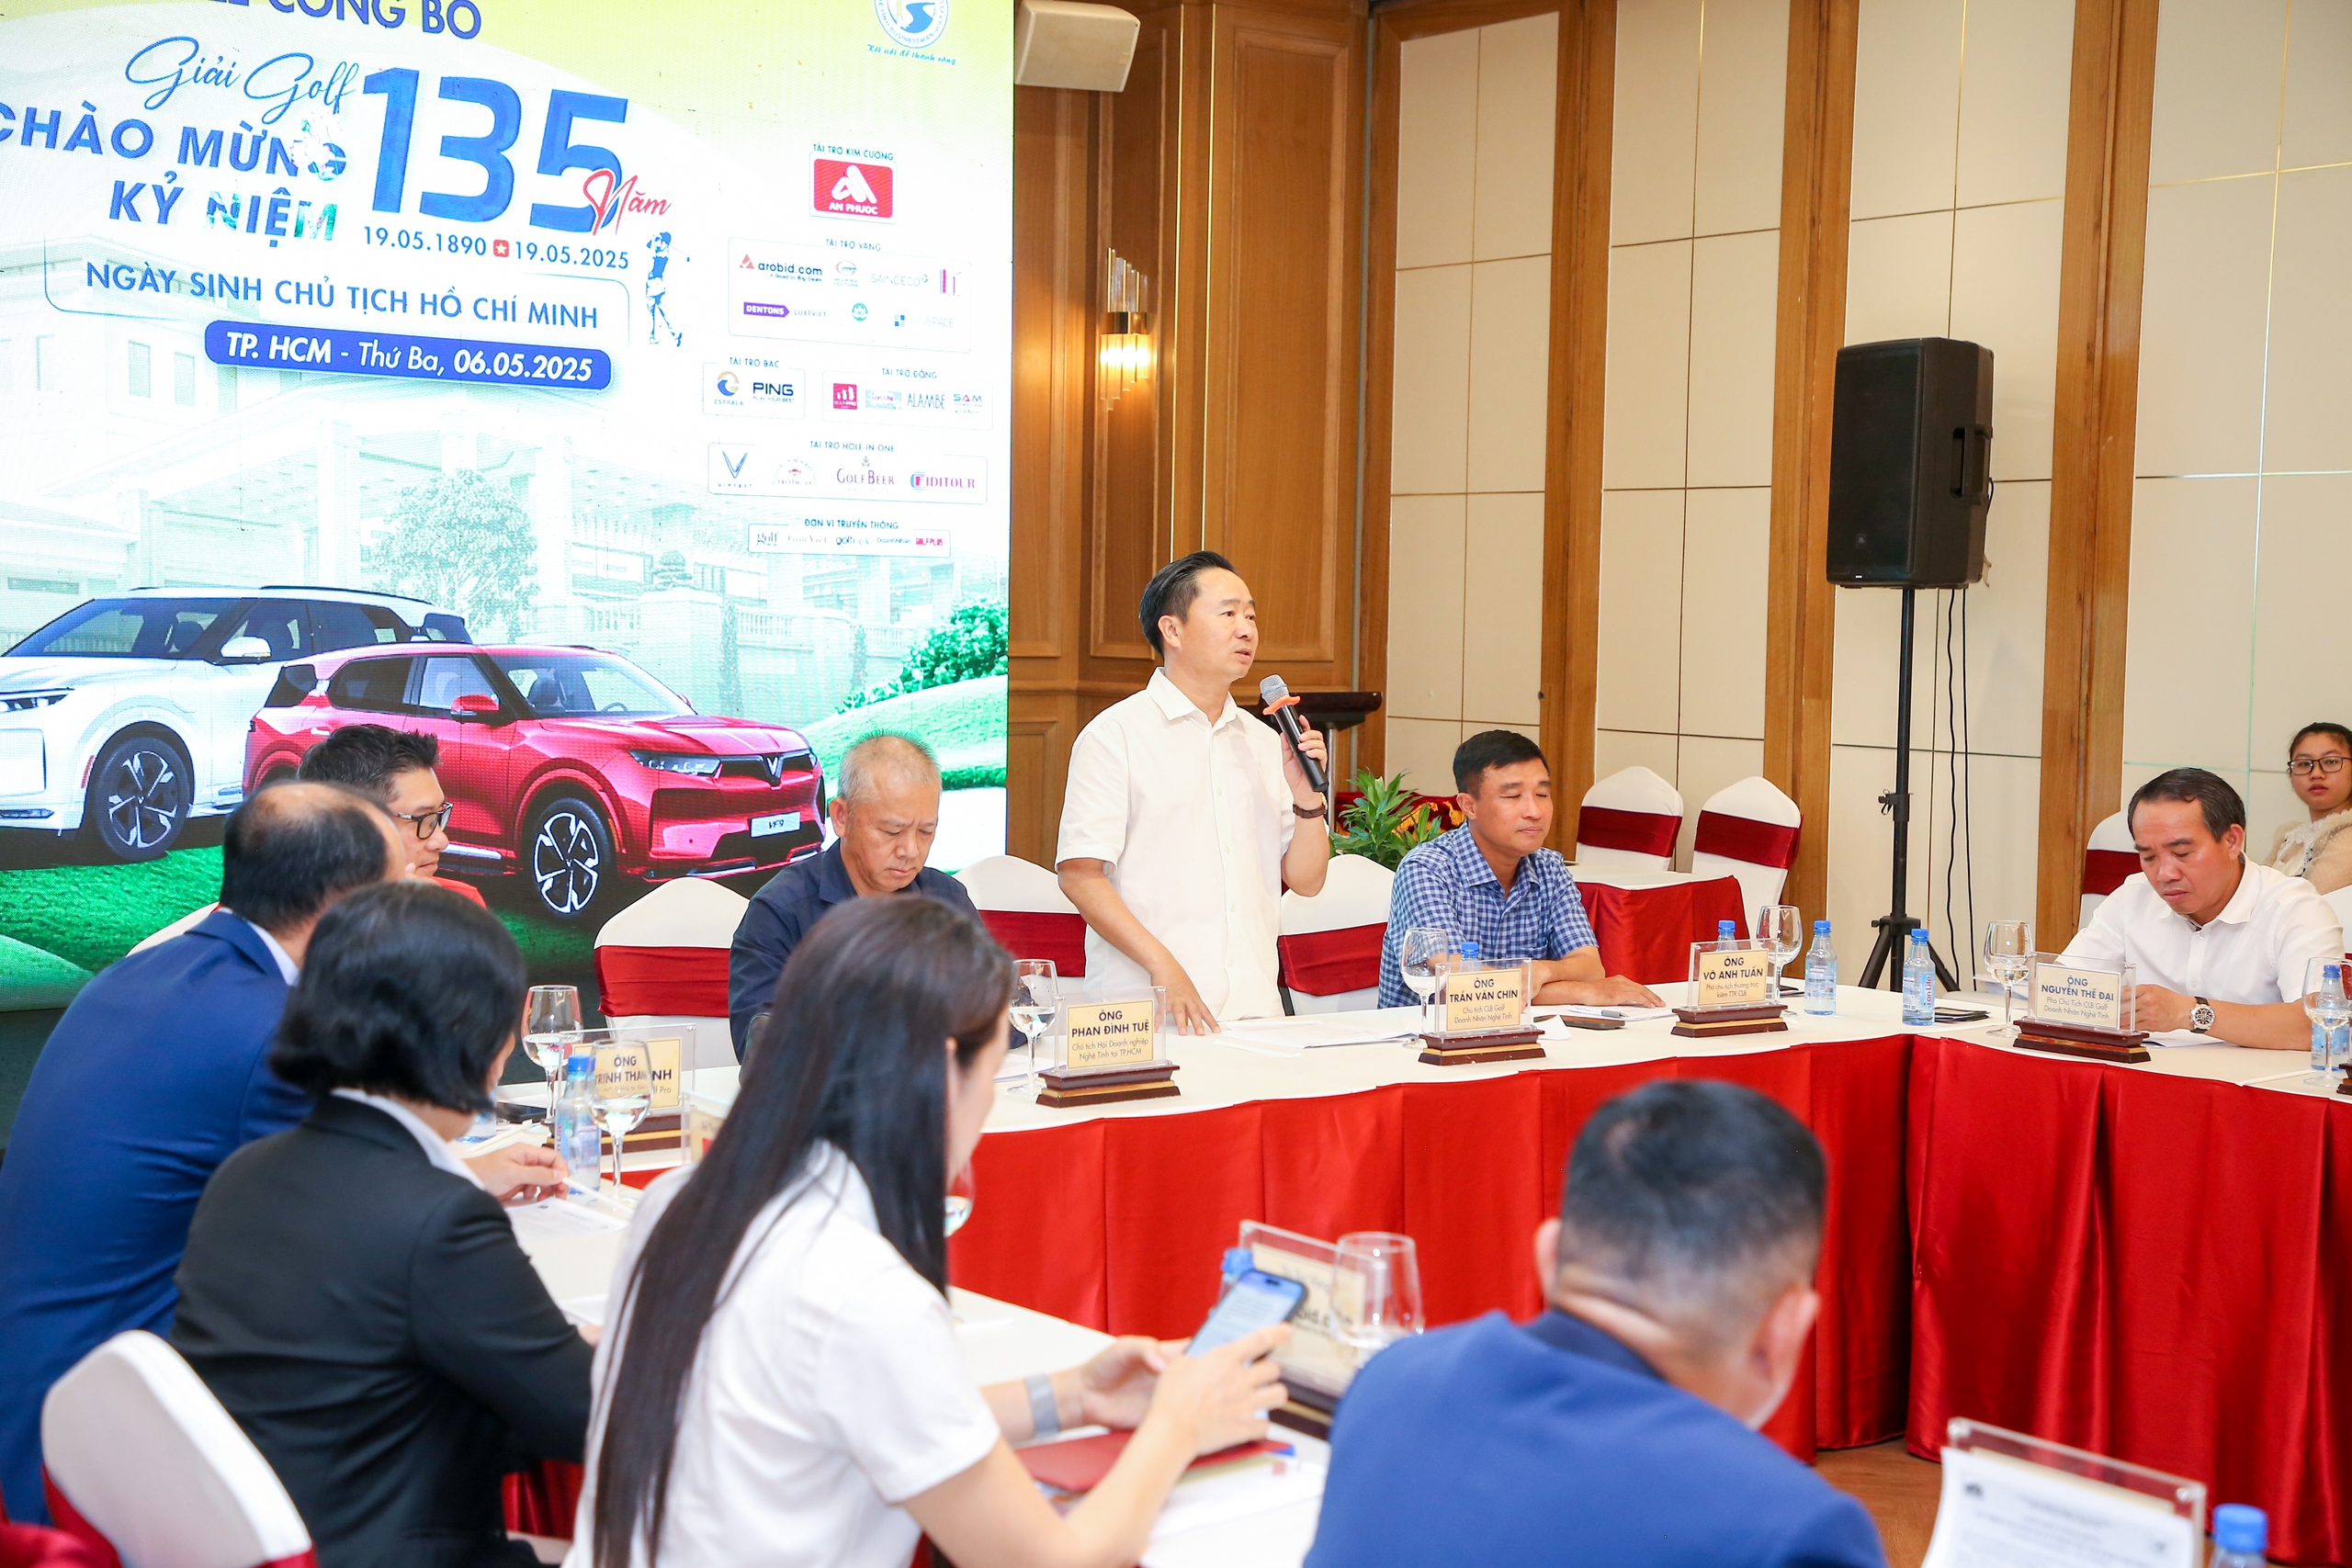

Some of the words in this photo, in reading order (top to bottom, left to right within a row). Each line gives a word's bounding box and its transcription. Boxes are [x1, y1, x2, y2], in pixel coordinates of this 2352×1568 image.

[126, 36, 241, 110] Giải
[243, 52, 359, 125] Golf
[363, 67, 628, 233] 135
[583, 170, 672, 236] Năm
[812, 142, 825, 153] TÀI
[845, 148, 861, 157] KIM
[109, 171, 184, 226] KỶ
[205, 186, 338, 248] NIỆM
[829, 202, 843, 211] AN
[365, 226, 487, 256] 19.05.1890
[515, 241, 629, 270] 19.05.2025
[758, 262, 823, 276] arobid.com
[87, 262, 177, 294] NGÀY
[190, 272, 262, 301] SINH
[276, 276, 334, 308] CHỦ
[346, 286, 408, 315] TỊCH
[420, 286, 463, 319] HỒ
[472, 295, 517, 322] CHÍ
[527, 301, 597, 329] MINH
[746, 305, 785, 316] DENTONS
[226, 331, 258, 360] TP.
[268, 334, 333, 364] HCM
[357, 339, 402, 368] Thứ
[407, 345, 445, 377] Ba,
[453, 348, 593, 382] 06.05.2025
[752, 382, 794, 397] PING
[953, 393, 983, 402] SAM
[1724, 955, 1745, 967] ÔNG
[1718, 970, 1738, 980] ANH
[1740, 965, 1764, 978] TUẤN
[1474, 977, 1495, 988] ÔNG
[2067, 976, 2088, 987] ÔNG
[1476, 990, 1495, 1000] VĂN
[2081, 987, 2097, 998] THẾ
[2098, 992, 2114, 1002] ĐẠI
[1495, 1003, 1505, 1011] Golf
[2044, 1005, 2063, 1013] Doanh
[2084, 1000, 2094, 1009] CLB
[2096, 1002, 2108, 1010] Golf
[1099, 1009, 1123, 1021] ÔNG
[1454, 1015, 1471, 1023] Doanh
[1071, 1026, 1101, 1038] PHAN
[1103, 1022, 1129, 1035] ĐÌNH
[1132, 1019, 1149, 1033] TUỆ
[1097, 1041, 1108, 1049] Hội
[1109, 1038, 1128, 1048] Doanh
[1129, 1036, 1149, 1047] nghiệp
[1079, 1052, 1096, 1062] Nghệ
[1120, 1047, 1142, 1057] TP.HCM
[614, 1055, 637, 1067] ÔNG
[660, 1086, 672, 1094] Pro
